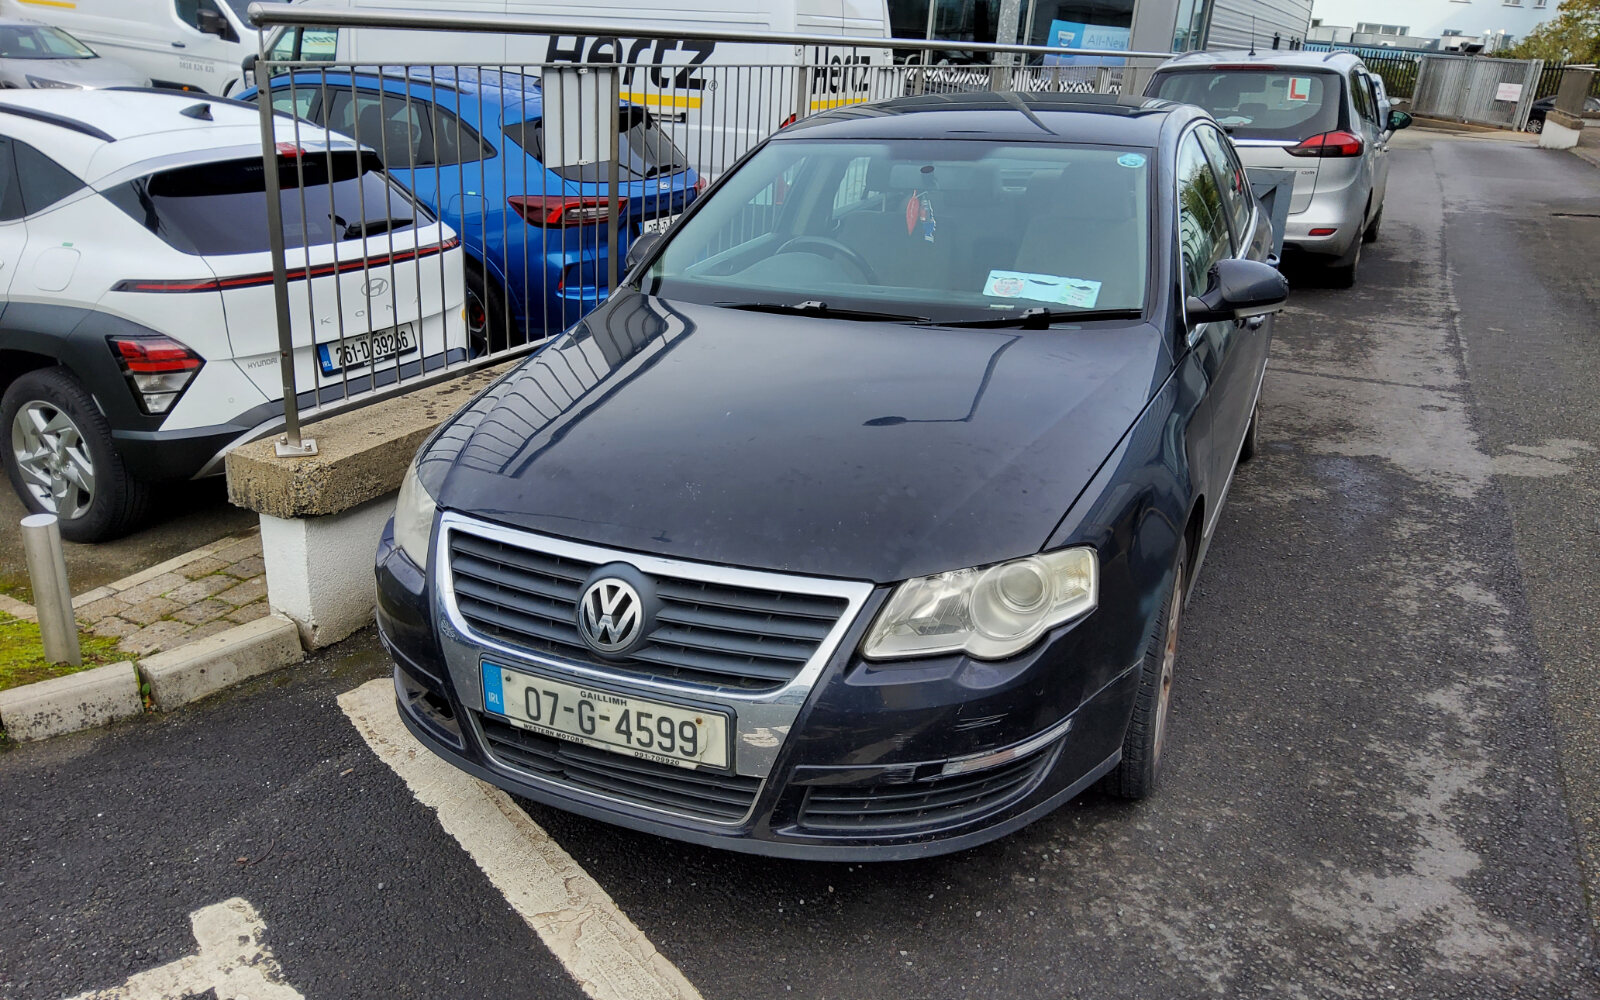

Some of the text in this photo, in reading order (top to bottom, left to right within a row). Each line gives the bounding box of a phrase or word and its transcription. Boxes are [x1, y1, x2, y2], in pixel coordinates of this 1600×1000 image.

[812, 46, 871, 95] Hertz
[1290, 78, 1307, 100] L
[335, 330, 409, 367] 261-D3926
[247, 357, 279, 370] HYUNDAI
[487, 691, 500, 705] IRL
[580, 690, 628, 706] GAILLIMH
[524, 686, 698, 758] 07-G-4599
[523, 723, 585, 744] WESTERN MOTORS
